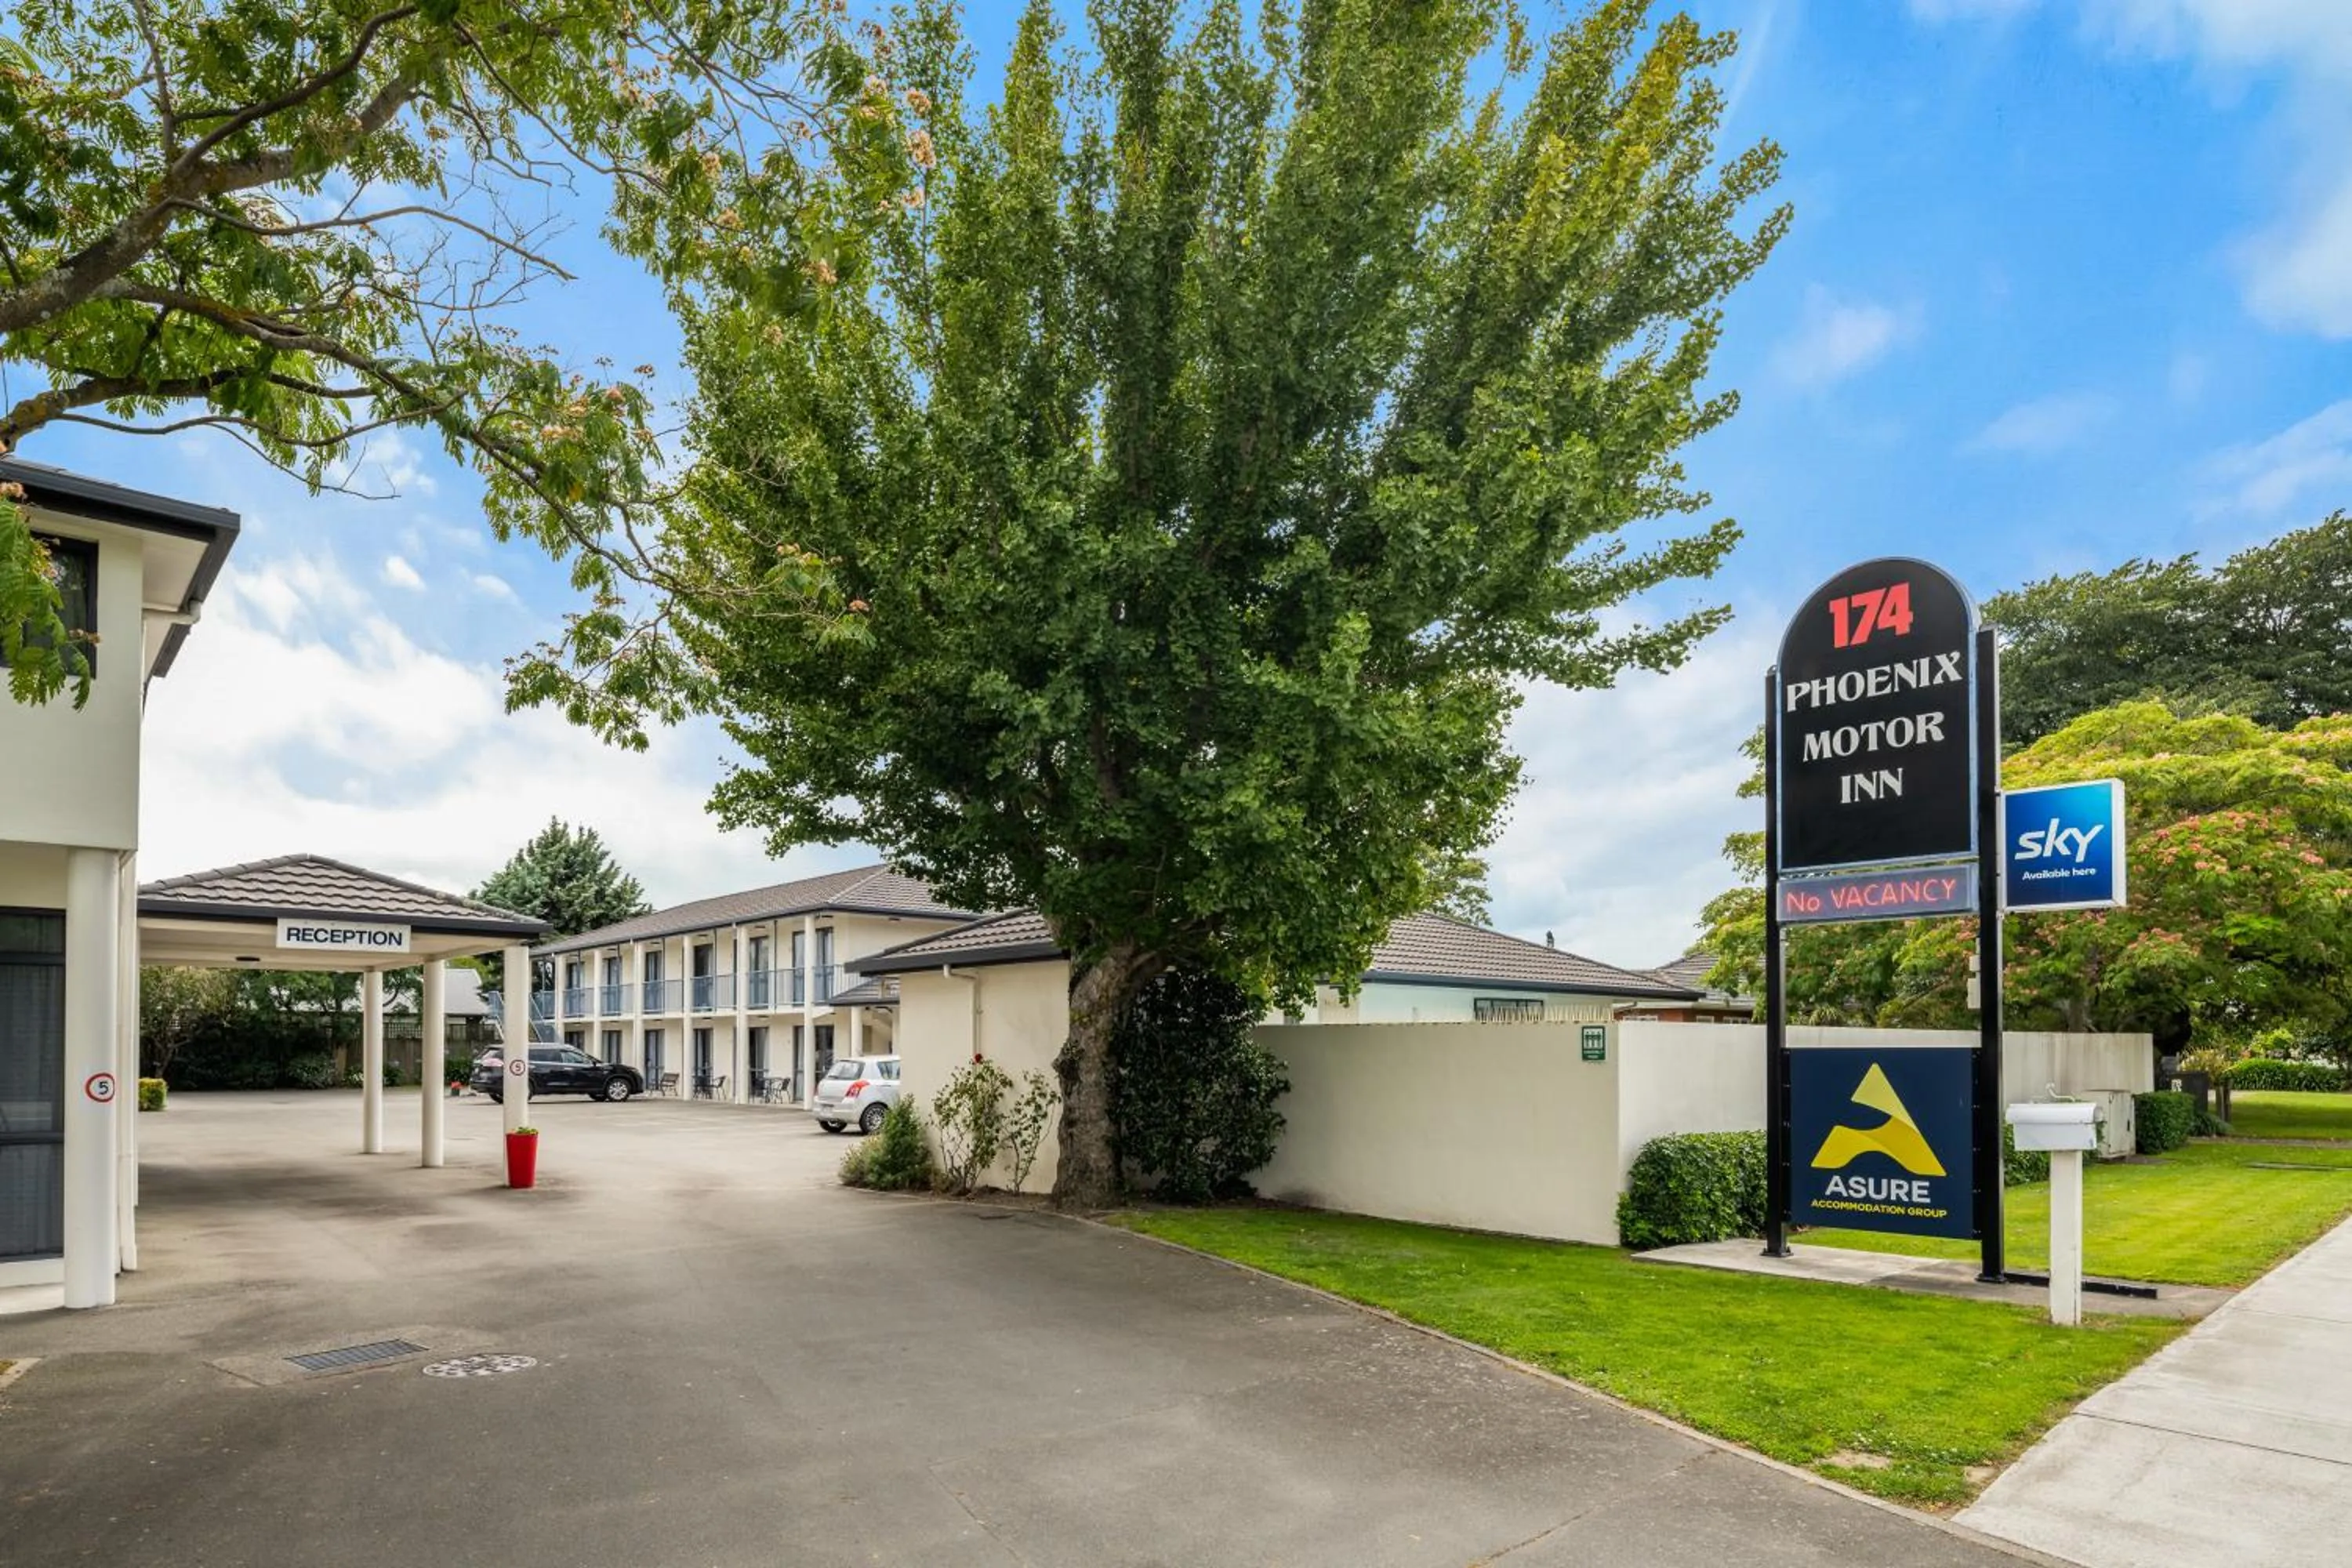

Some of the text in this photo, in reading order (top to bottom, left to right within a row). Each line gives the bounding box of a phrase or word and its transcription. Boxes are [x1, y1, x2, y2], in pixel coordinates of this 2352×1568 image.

[1829, 582, 1914, 648] 174
[1786, 650, 1963, 713] PHOENIX
[1802, 711, 1945, 763] MOTOR
[1839, 768, 1904, 804] INN
[2014, 817, 2105, 863] sky
[2022, 866, 2097, 880] Available here
[1785, 878, 1957, 913] No VACANCY
[286, 926, 402, 946] RECEPTION
[98, 1081, 109, 1096] 5
[1824, 1174, 1931, 1203] ASURE
[1810, 1199, 1947, 1218] ACCOMMODATION GROUP
